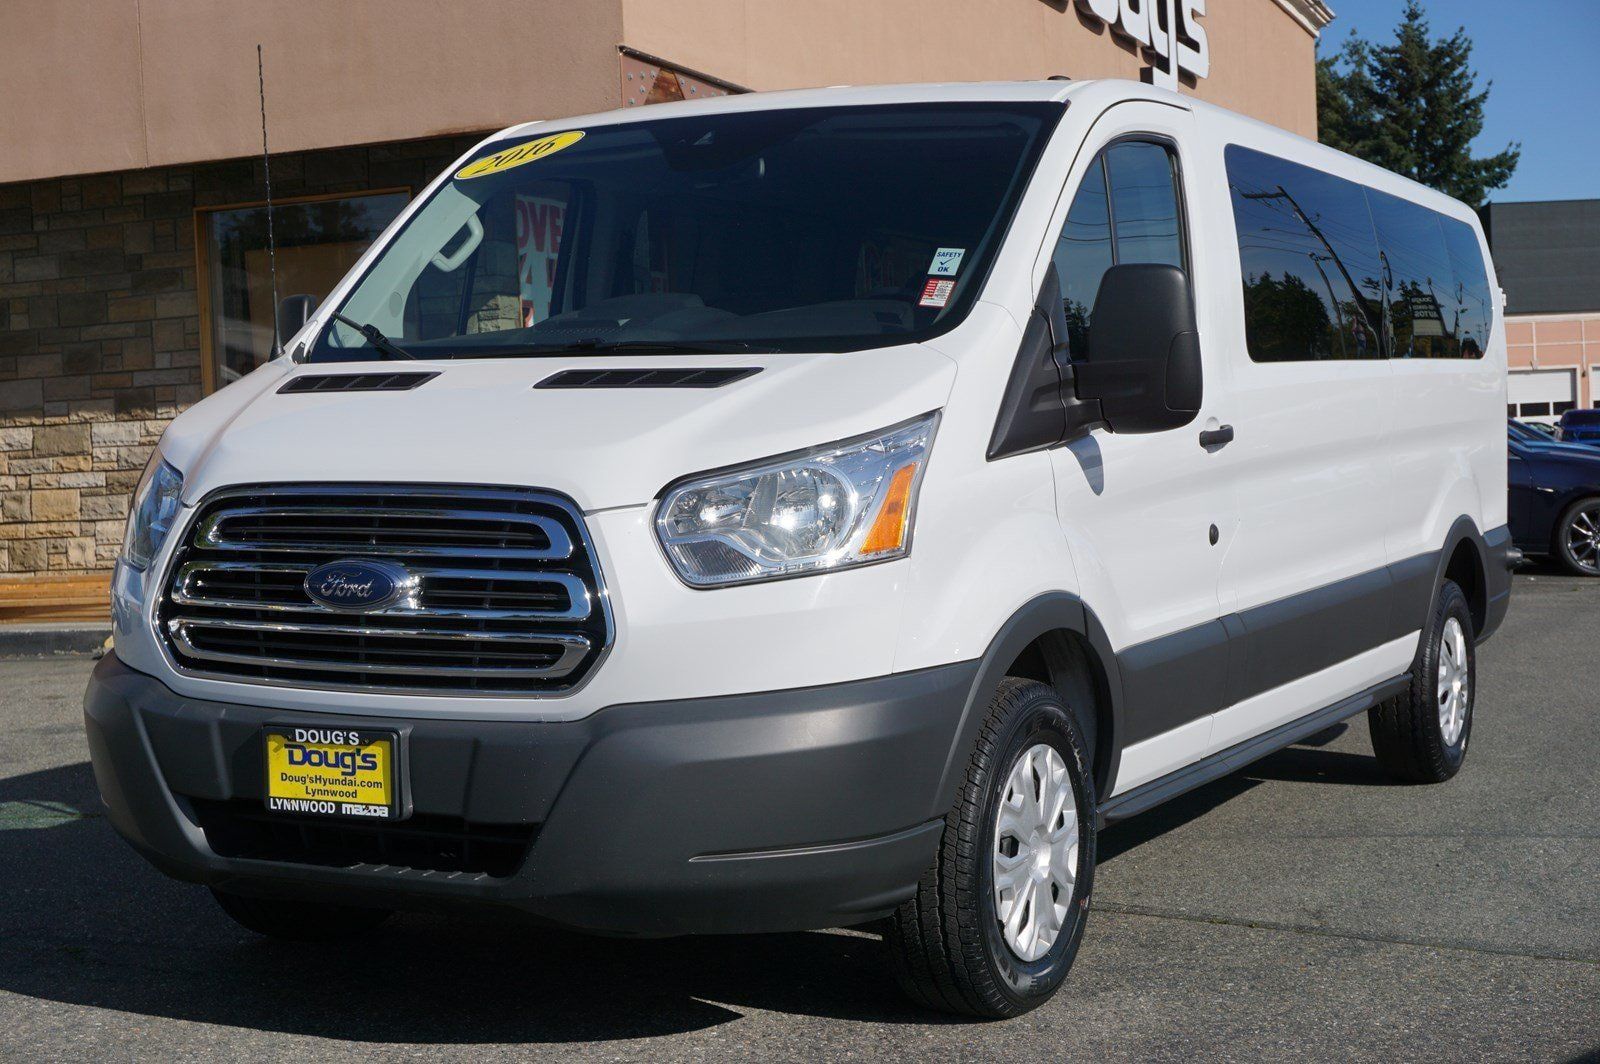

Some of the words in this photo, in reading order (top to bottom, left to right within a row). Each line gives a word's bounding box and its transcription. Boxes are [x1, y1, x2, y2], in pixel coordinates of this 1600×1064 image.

[470, 136, 561, 175] 2016
[320, 571, 374, 597] Ford
[295, 728, 360, 746] DOUG'S
[284, 743, 378, 776] Doug's
[280, 772, 383, 789] Doug'sHyundai.com
[305, 786, 358, 799] Lynnwood
[270, 797, 336, 814] LYNNWOOD
